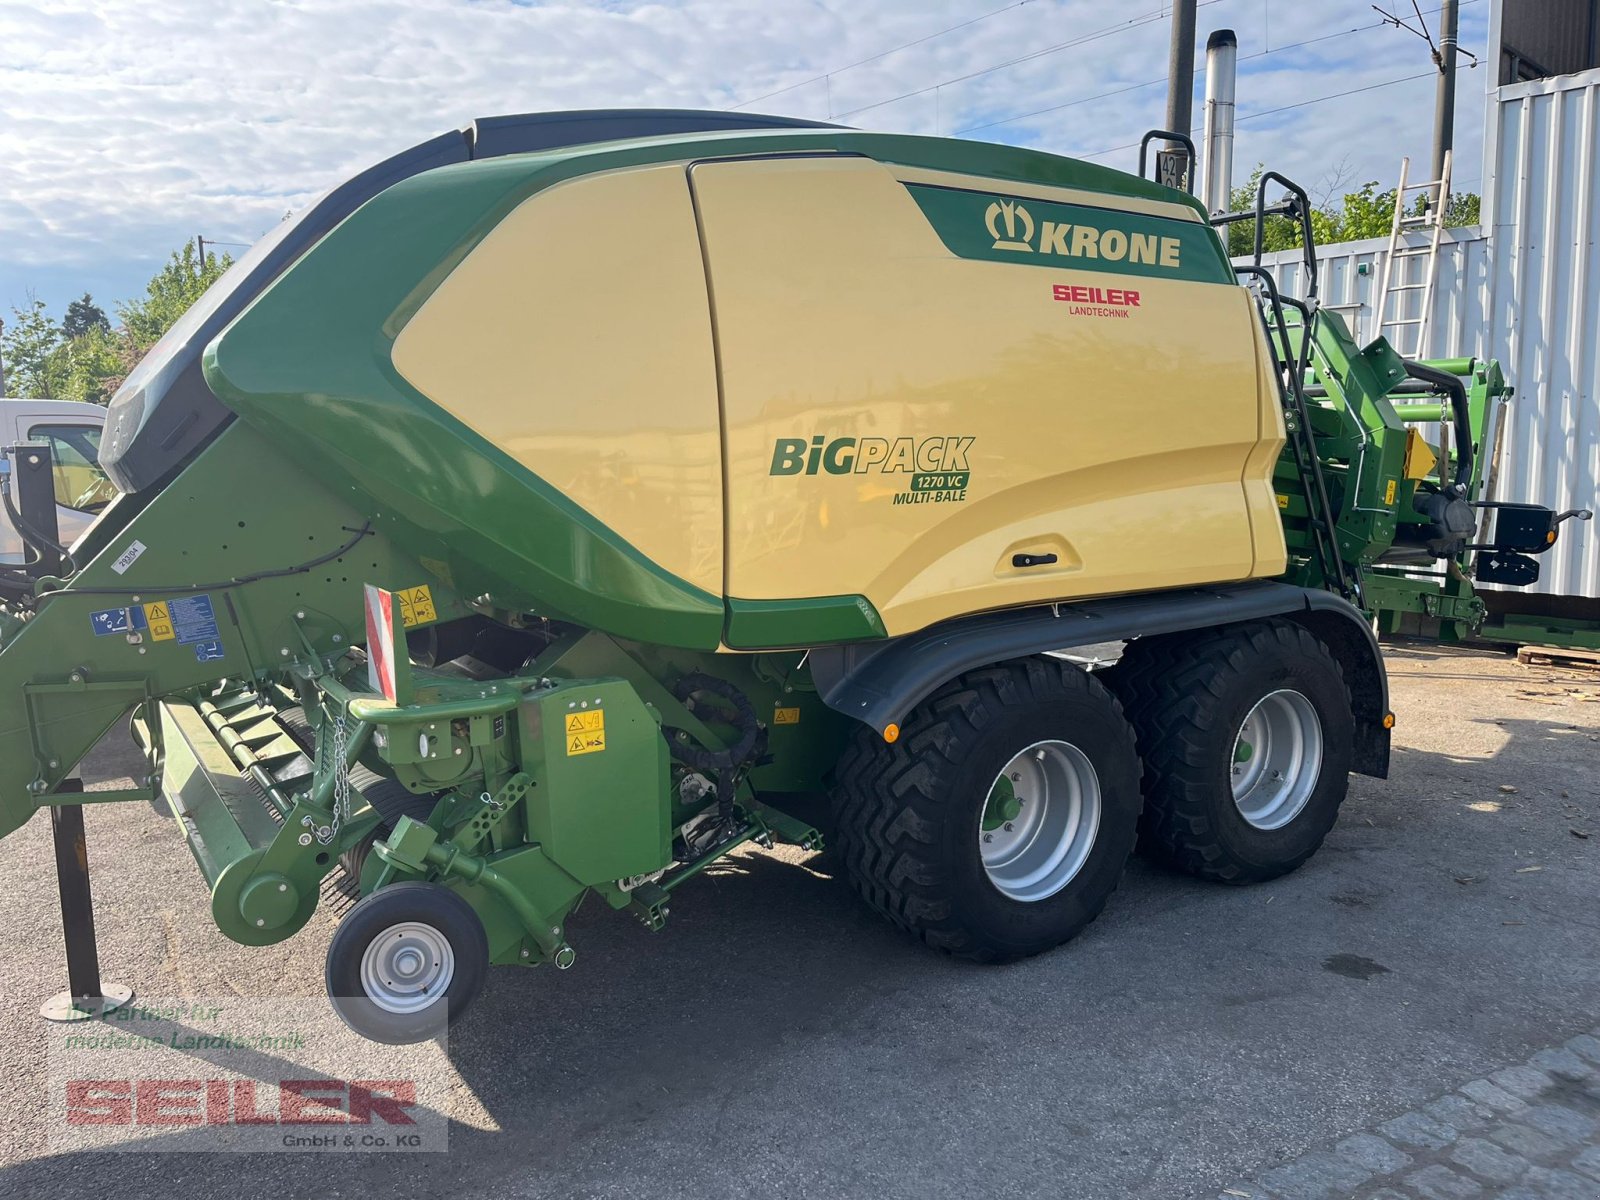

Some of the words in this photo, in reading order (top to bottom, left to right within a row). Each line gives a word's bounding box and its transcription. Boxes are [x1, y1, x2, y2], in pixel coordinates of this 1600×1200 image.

[1162, 156, 1175, 176] 42
[1039, 221, 1181, 267] KRONE
[1053, 284, 1141, 306] SEILER
[1069, 306, 1130, 318] LANDTECHNIK
[917, 476, 944, 489] 1270
[947, 475, 963, 488] VC
[893, 489, 967, 505] MULTI-BALE
[119, 548, 138, 567] 293/04
